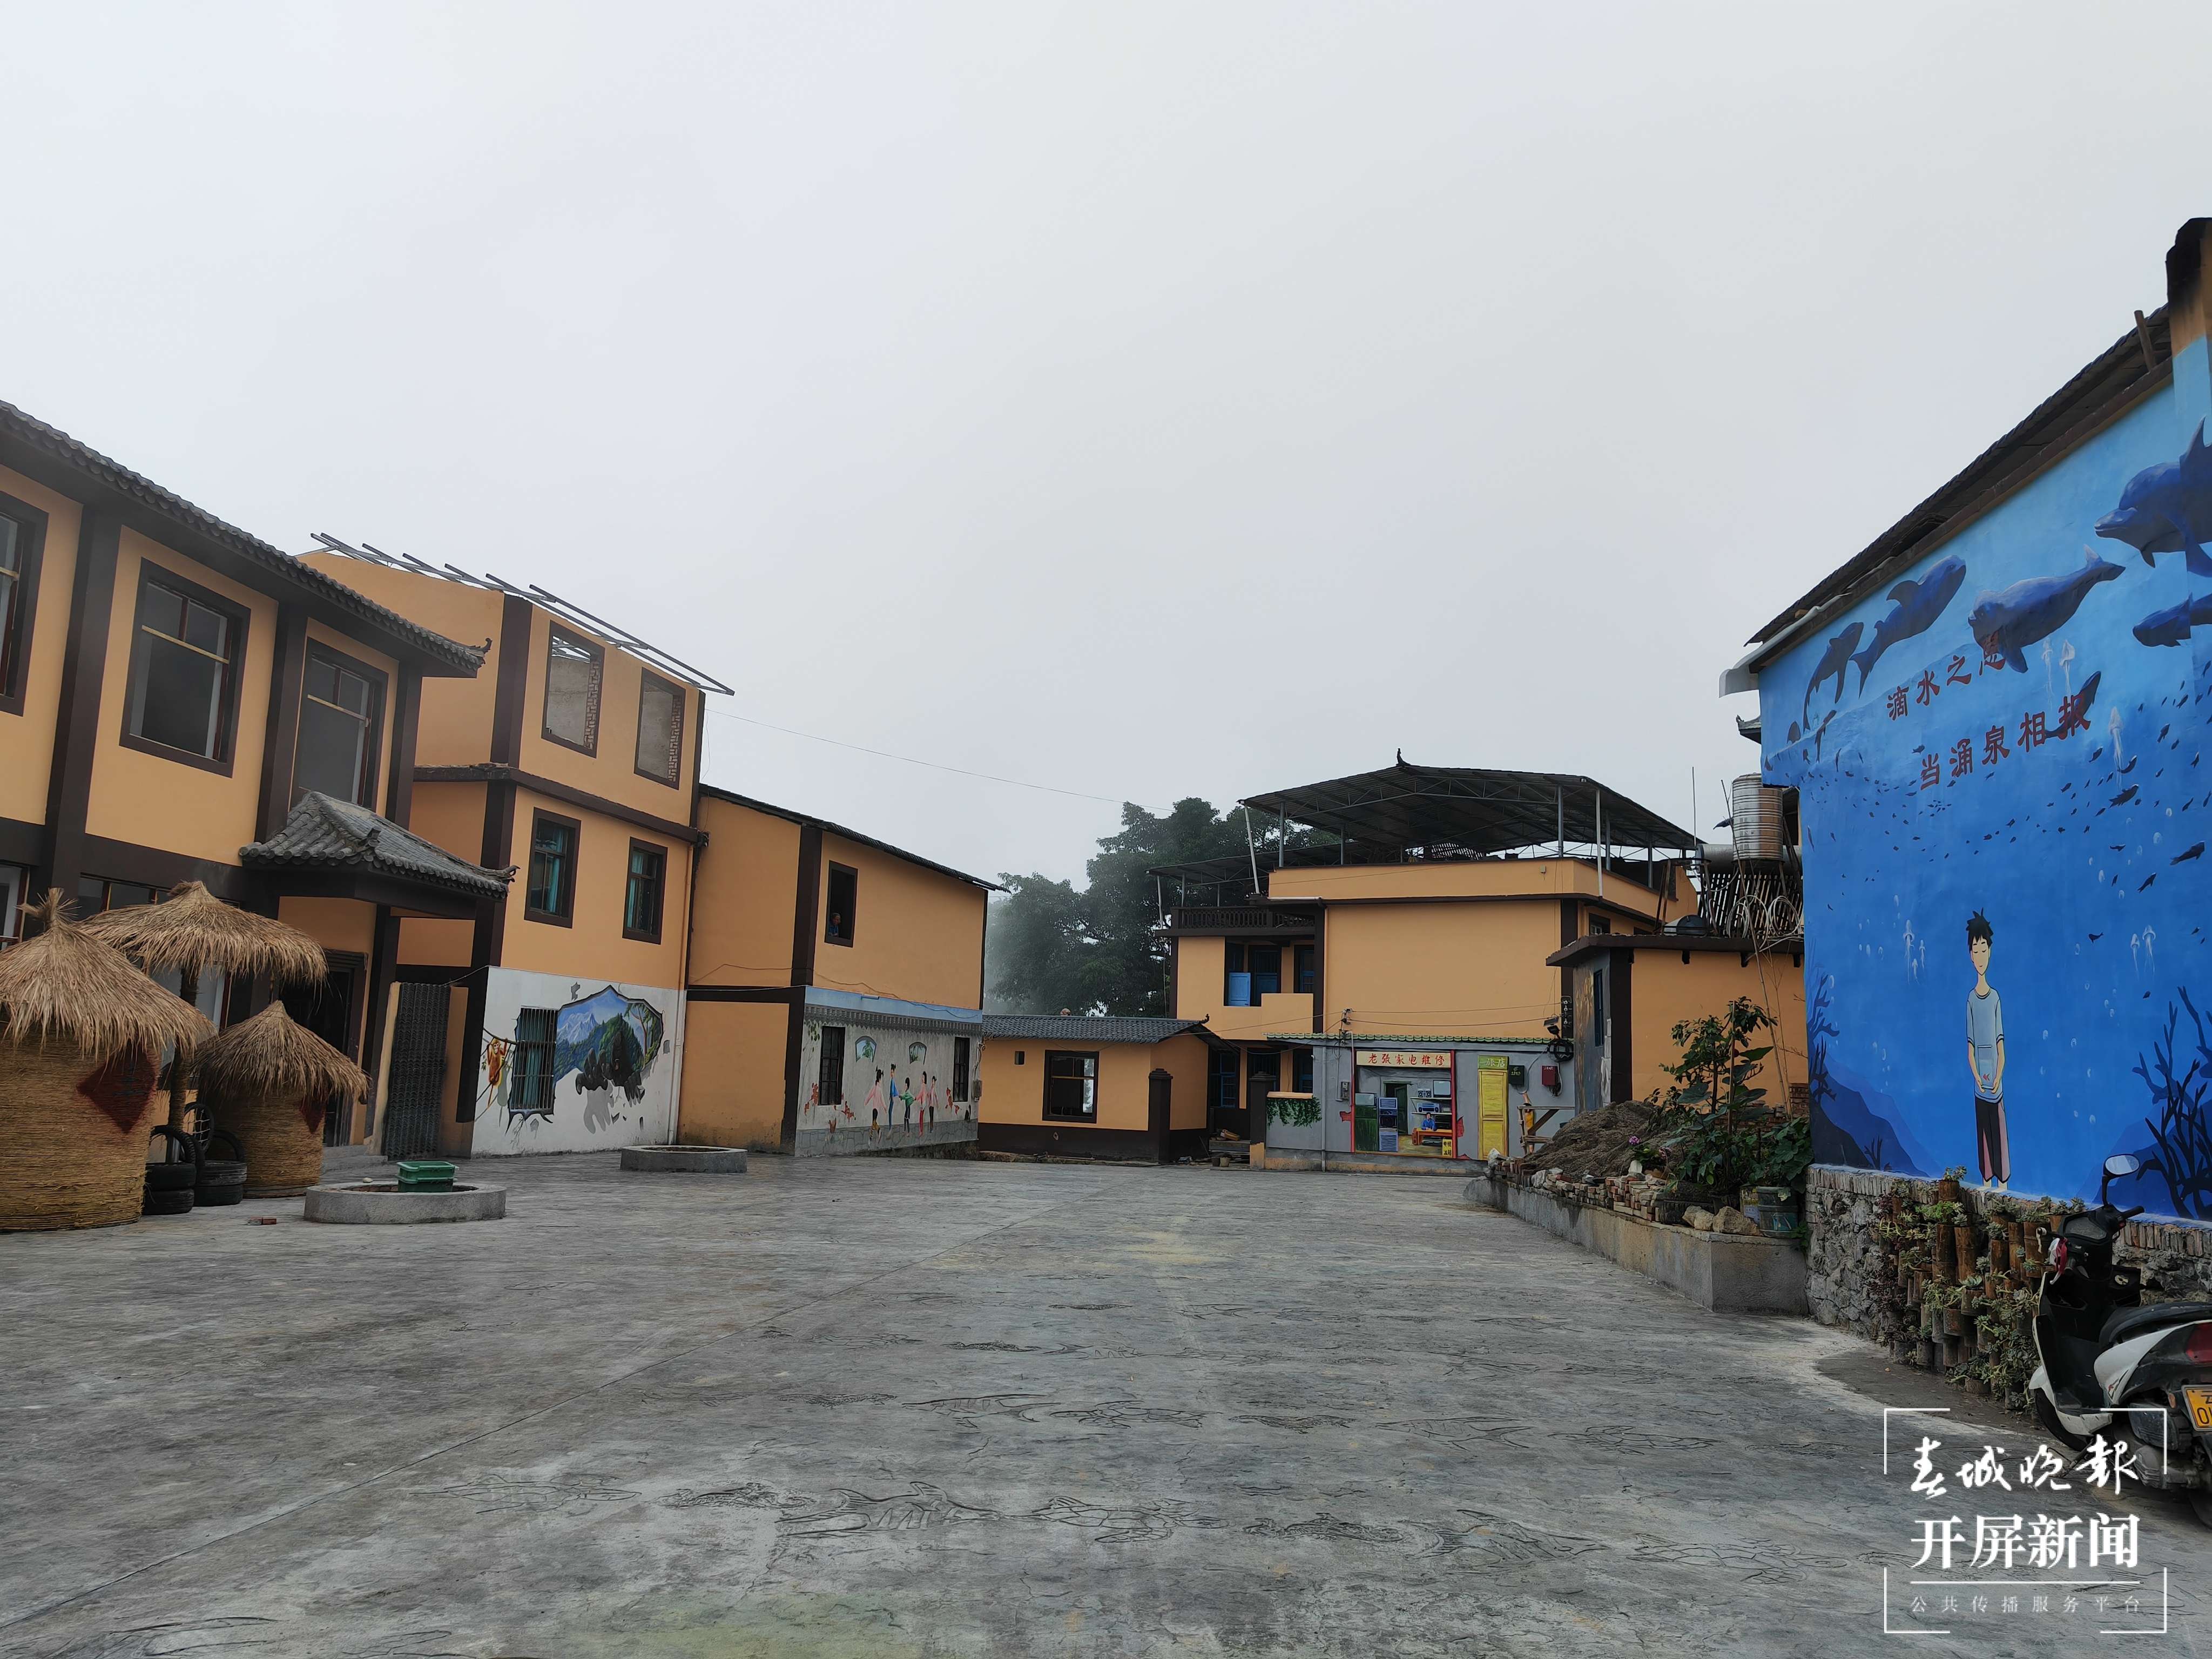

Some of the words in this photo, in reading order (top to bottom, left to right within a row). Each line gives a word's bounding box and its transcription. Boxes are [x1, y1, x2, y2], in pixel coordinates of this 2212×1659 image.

[1920, 694, 2091, 791] 当涌泉相报
[1486, 1058, 1505, 1068] 旅店
[2197, 1407, 2212, 1424] 0
